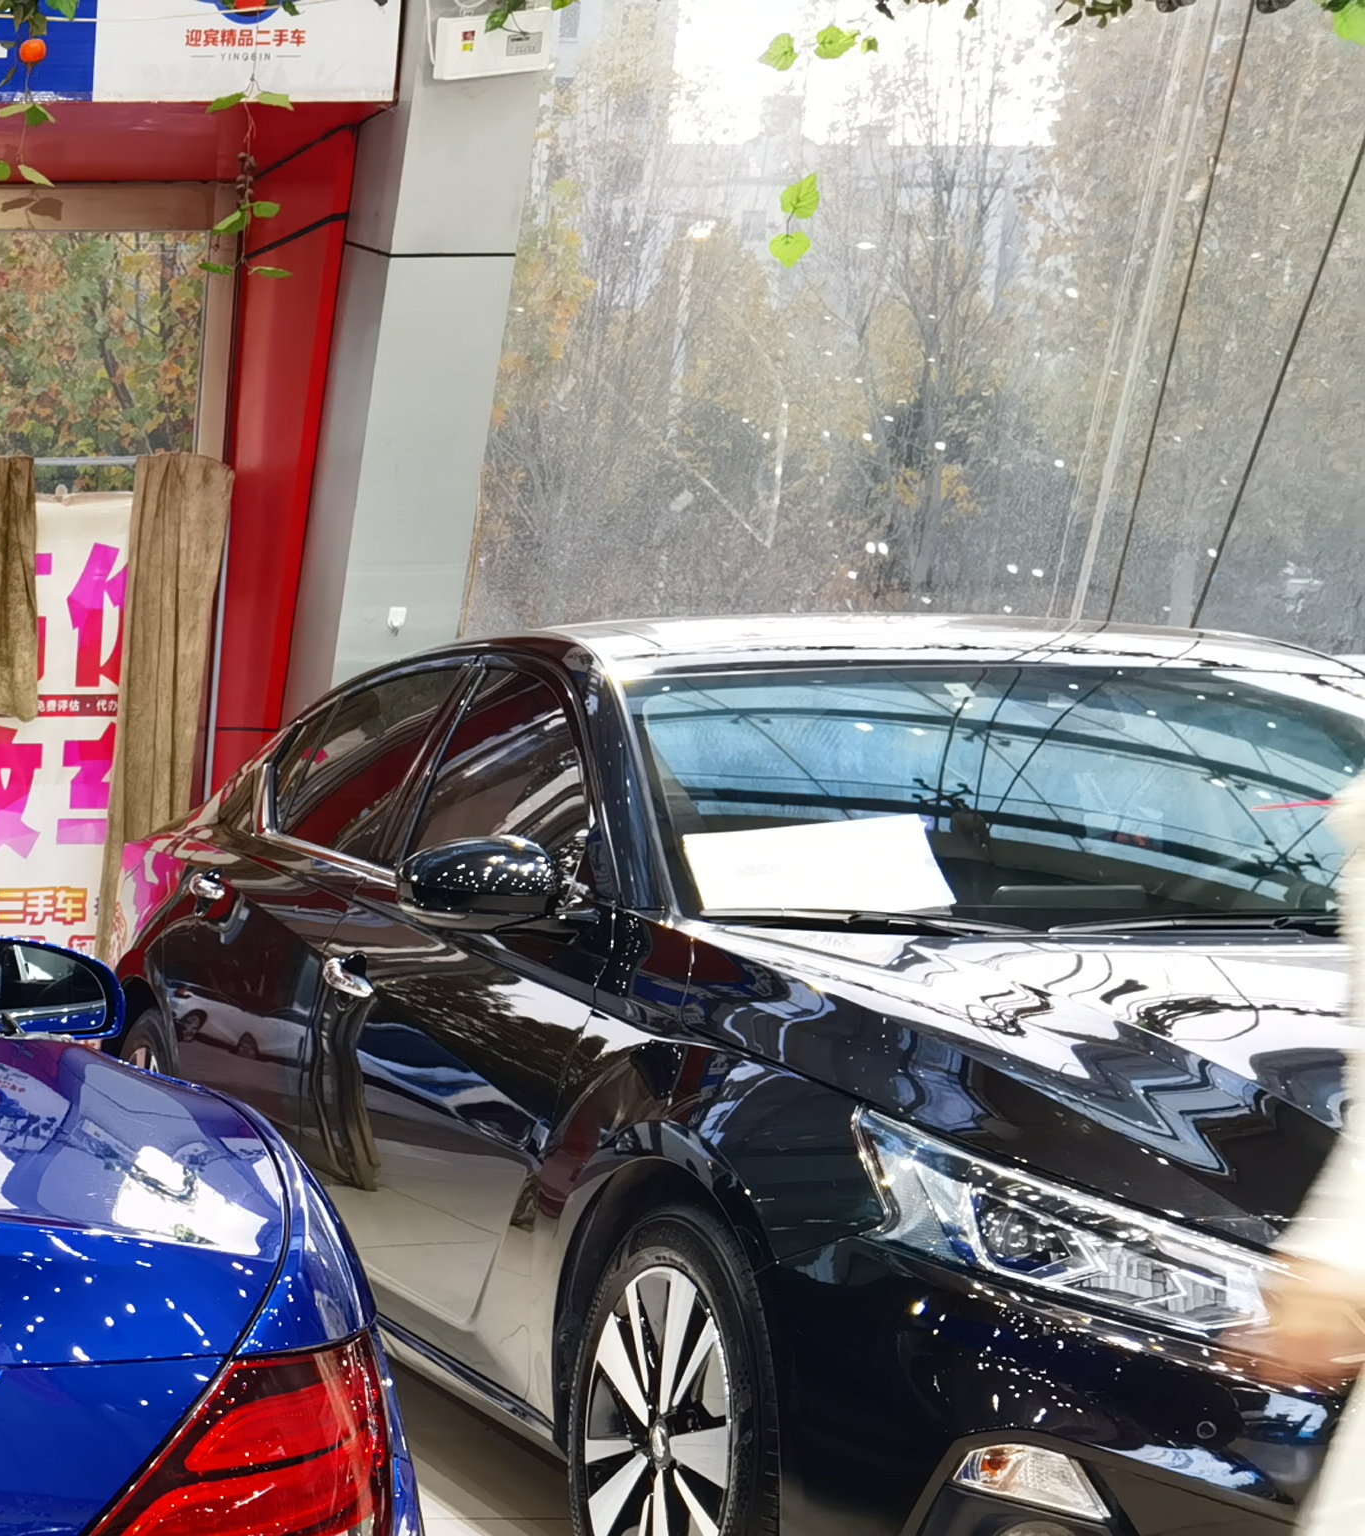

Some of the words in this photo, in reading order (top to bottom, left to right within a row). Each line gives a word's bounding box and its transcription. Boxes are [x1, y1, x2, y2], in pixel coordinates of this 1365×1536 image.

[185, 28, 307, 48] 迎宾精品二手车
[220, 52, 272, 62] YINGBIN
